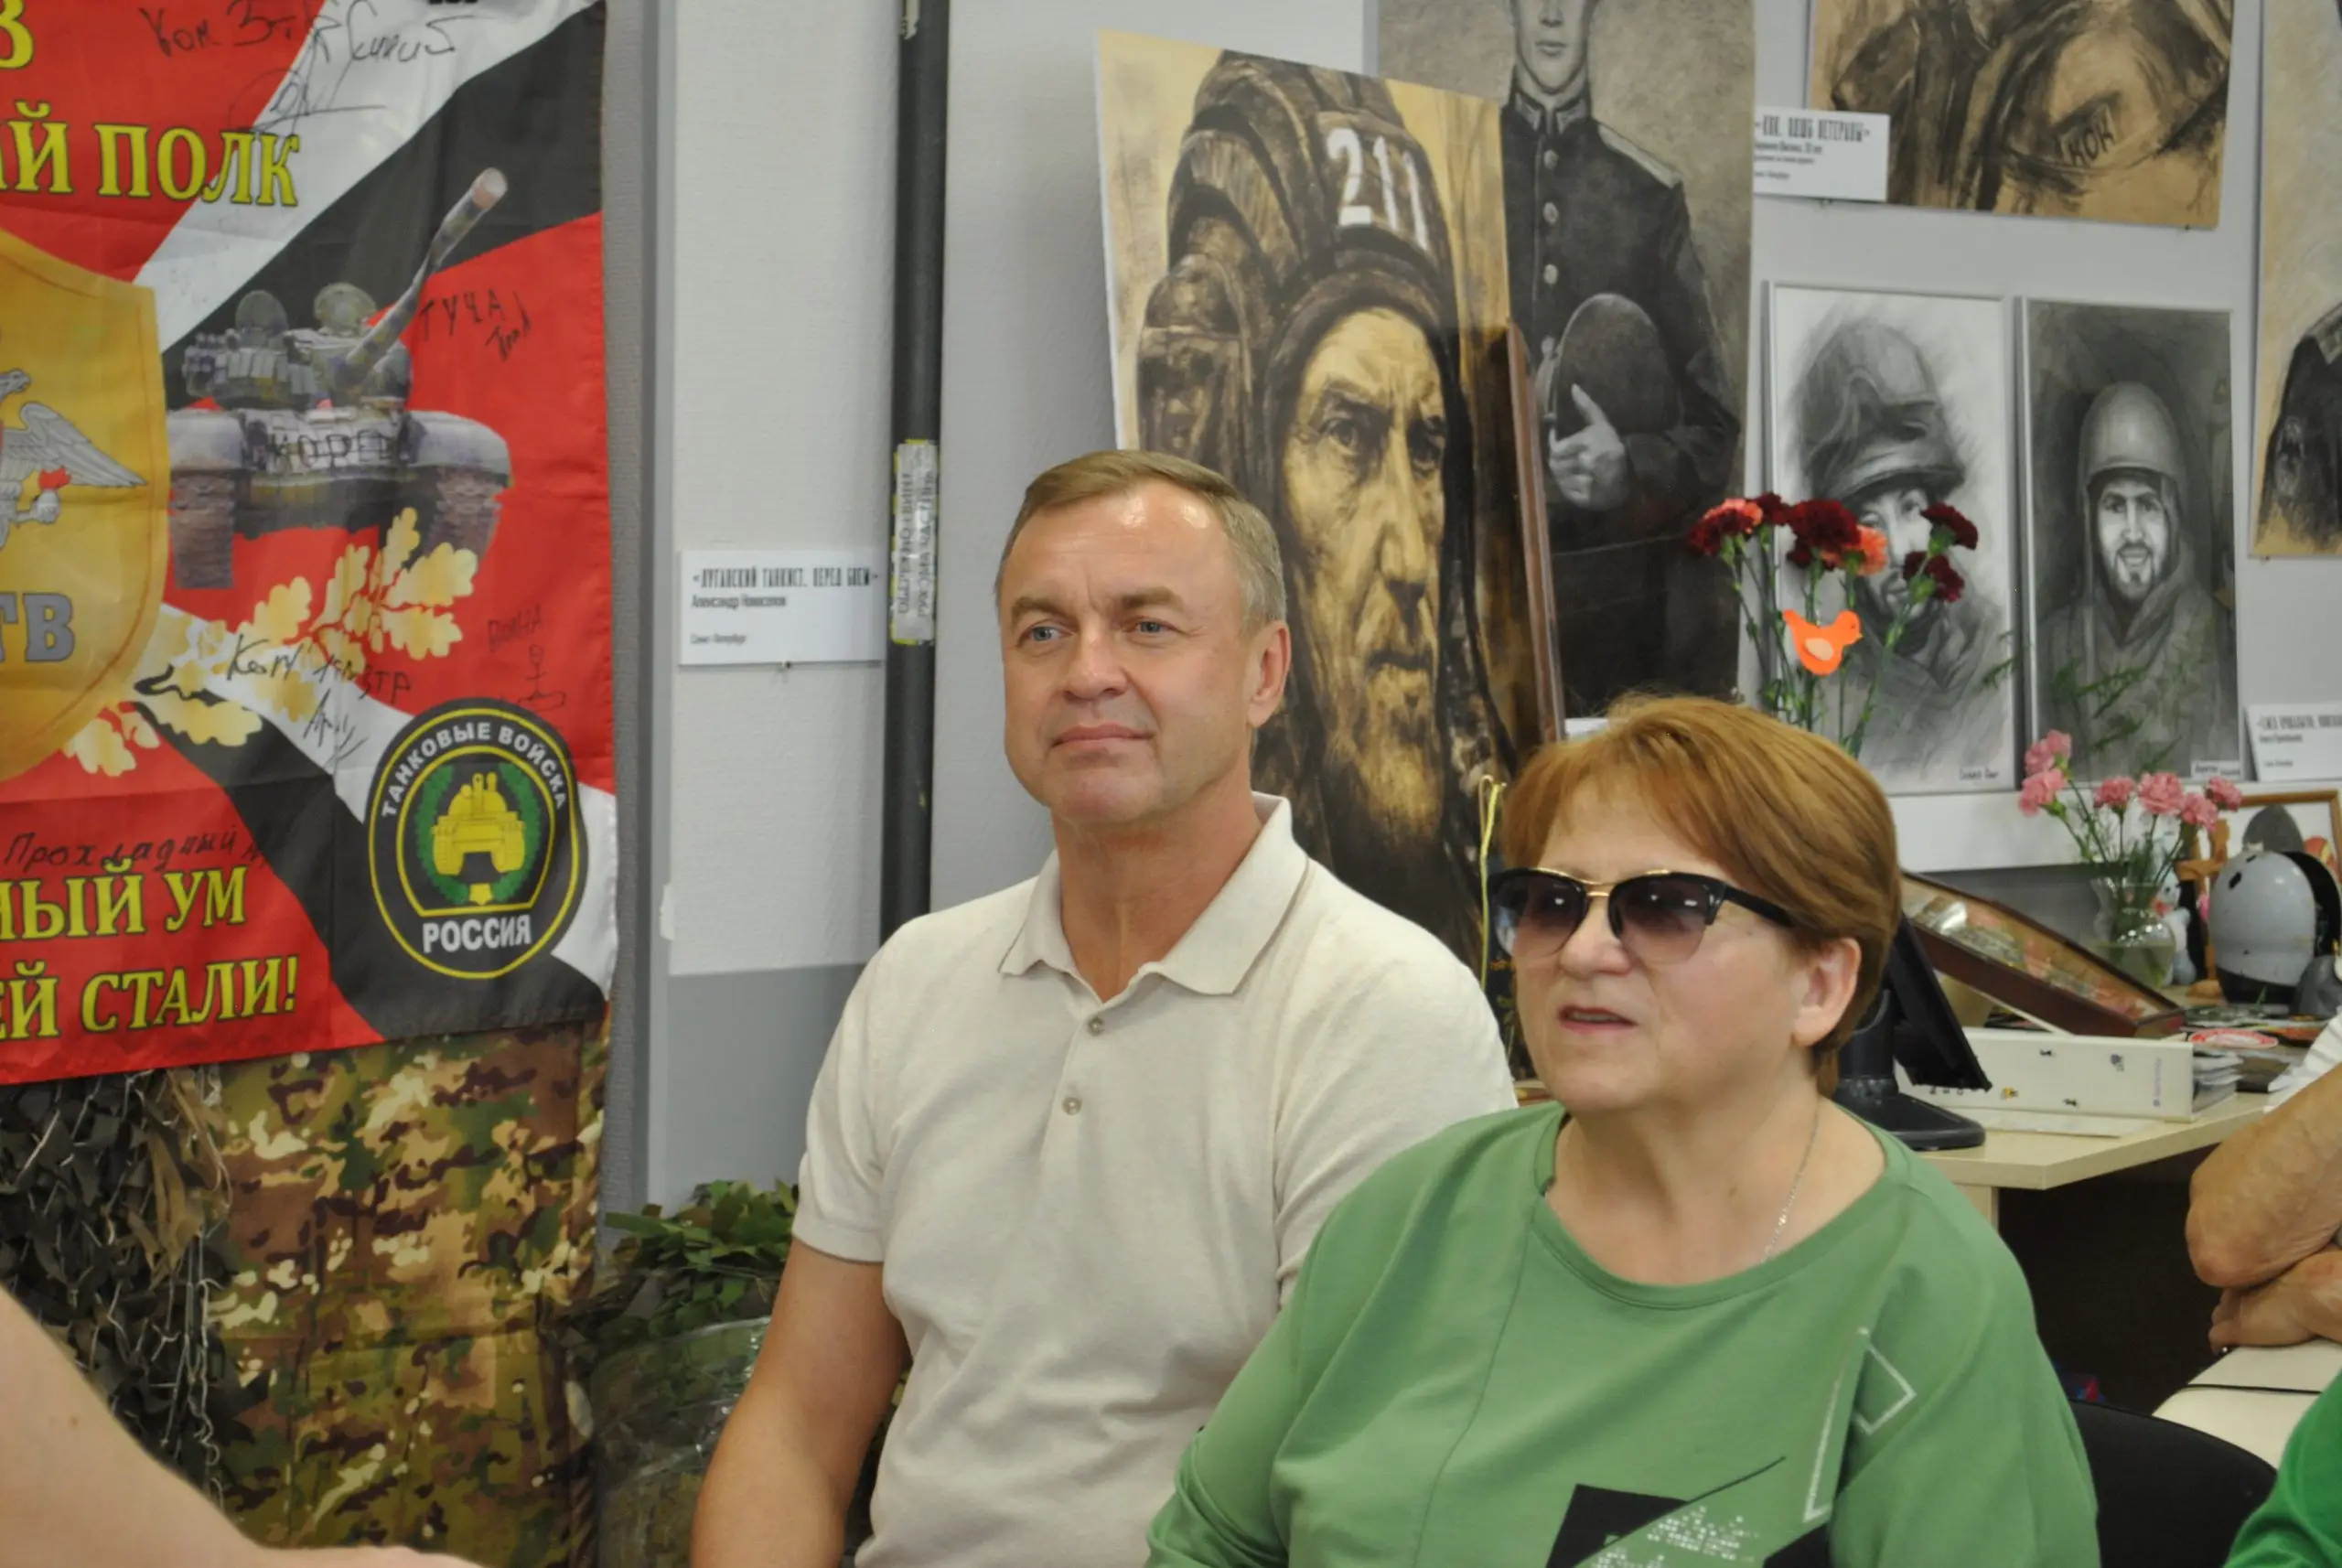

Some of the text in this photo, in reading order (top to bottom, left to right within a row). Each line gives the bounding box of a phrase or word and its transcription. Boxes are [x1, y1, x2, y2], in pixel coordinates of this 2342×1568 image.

[0, 99, 300, 207] Й ПОЛК
[1326, 127, 1429, 252] 211
[381, 721, 491, 819] ТАНКОВЫЕ
[497, 725, 567, 810] ВОЙСКА
[163, 865, 248, 931] УМ
[423, 915, 532, 953] РОССИЯ
[0, 954, 298, 1041] Й СТАЛИ!
